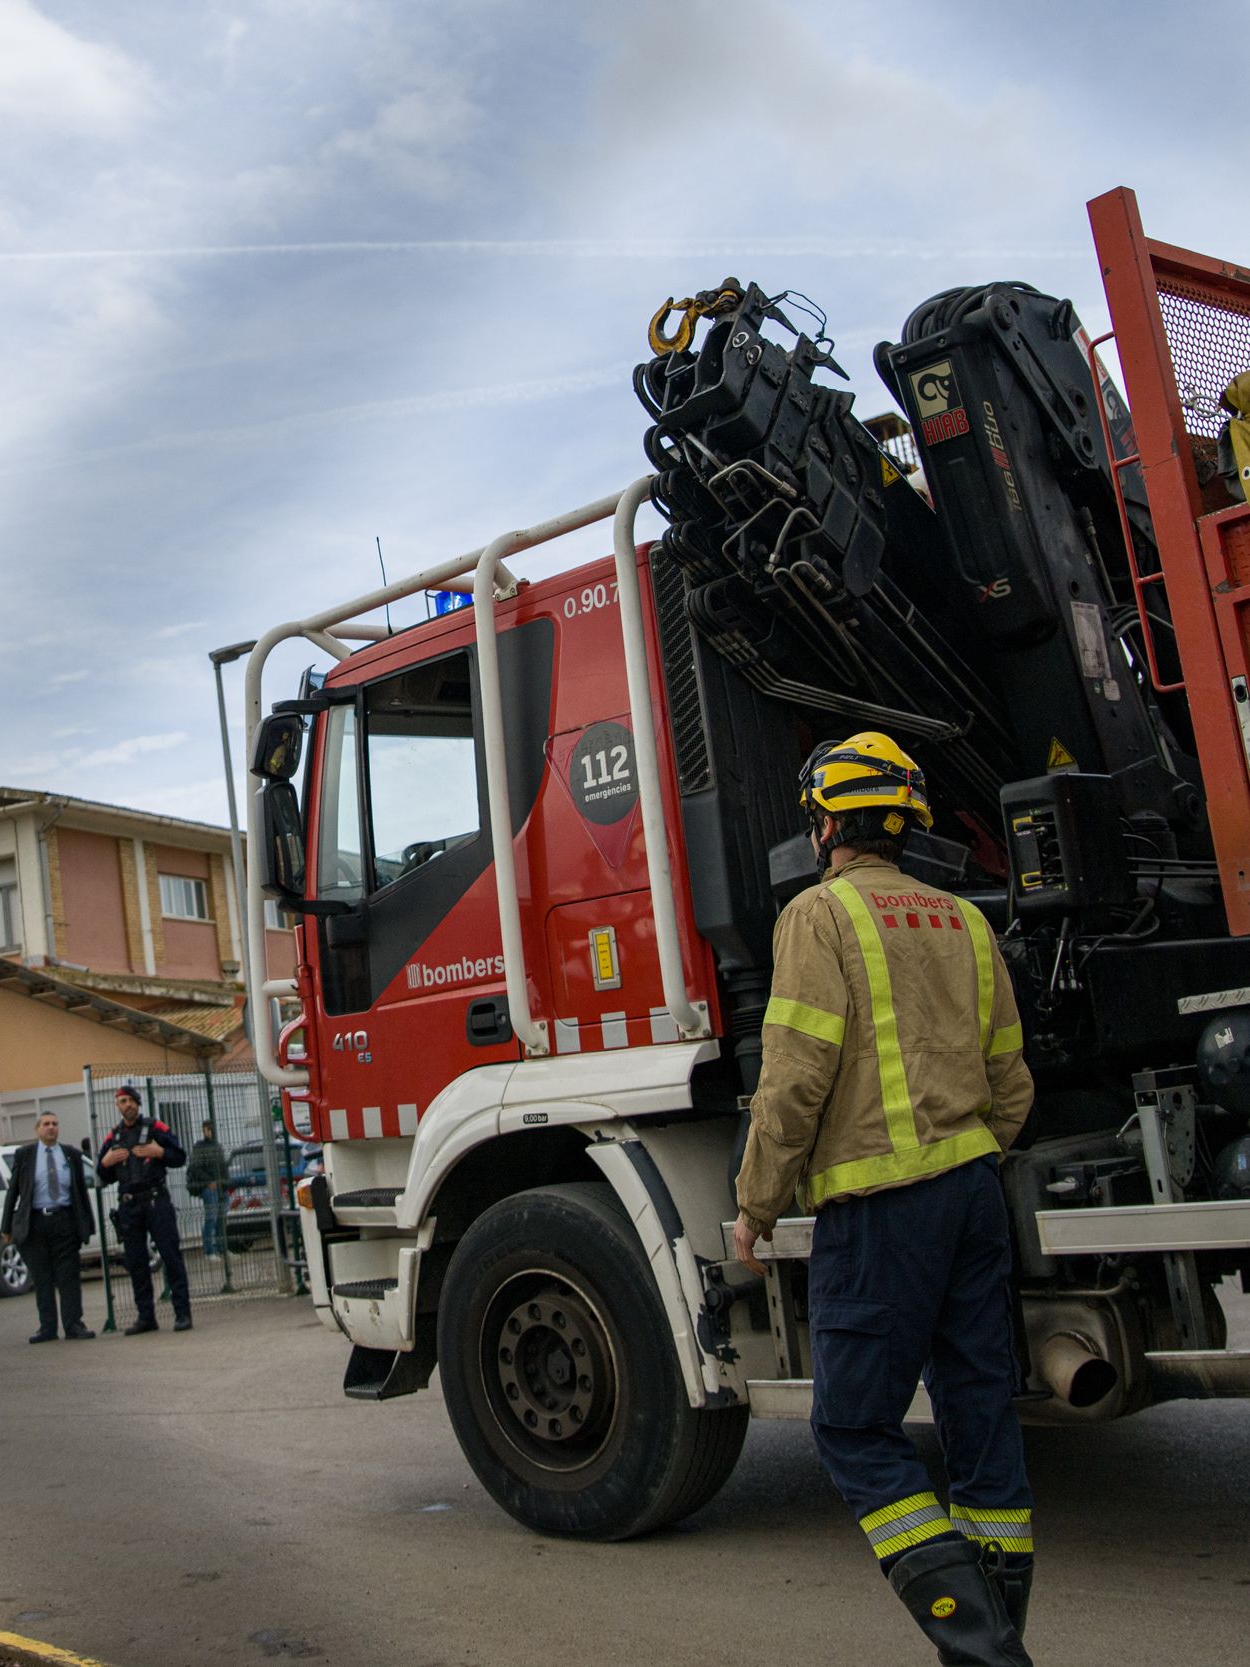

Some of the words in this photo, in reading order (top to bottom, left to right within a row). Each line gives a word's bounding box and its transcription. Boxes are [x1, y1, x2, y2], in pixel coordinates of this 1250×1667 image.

[921, 408, 970, 446] HIAB
[581, 745, 630, 789] 112
[584, 783, 632, 802] emergències
[870, 891, 953, 911] bombers
[422, 955, 506, 987] bombers
[333, 1030, 368, 1052] 410
